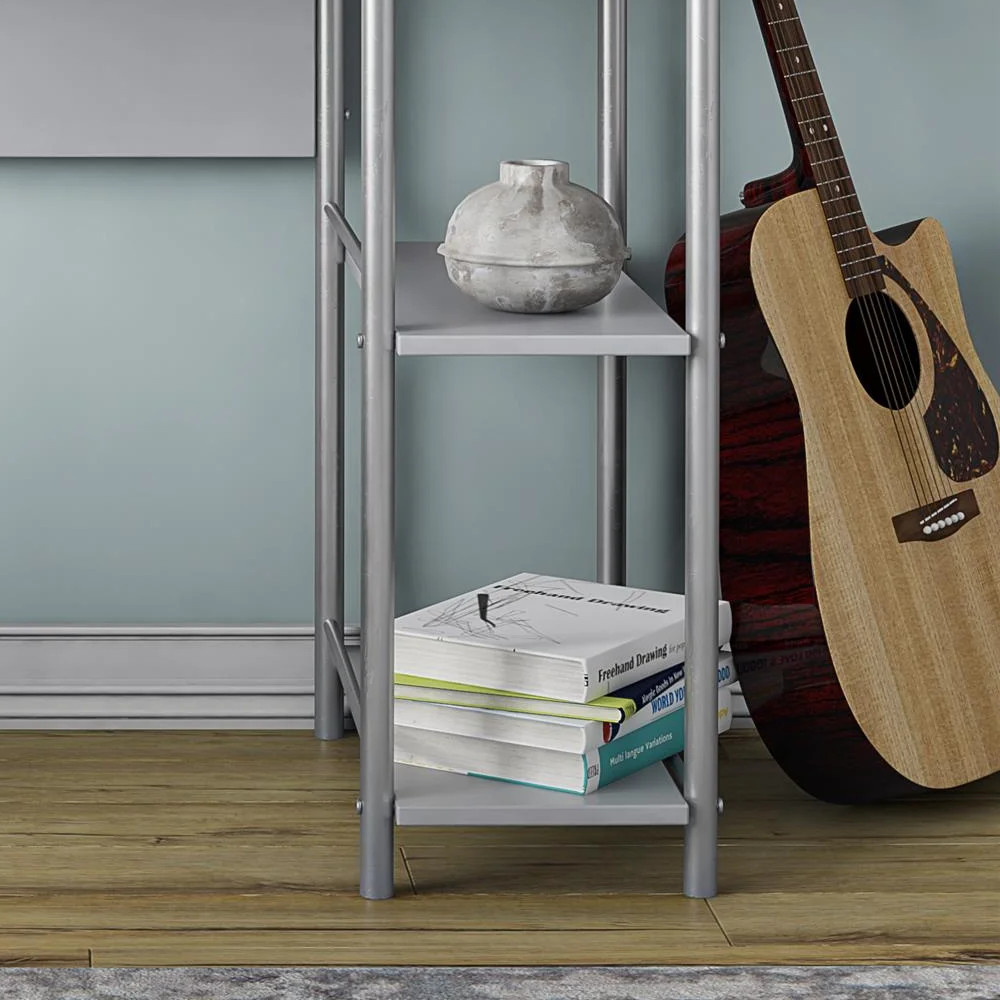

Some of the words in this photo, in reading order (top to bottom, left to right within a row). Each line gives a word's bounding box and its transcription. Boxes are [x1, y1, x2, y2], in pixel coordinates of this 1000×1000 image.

[598, 656, 634, 683] Freehand
[636, 643, 668, 667] Drawing
[651, 691, 674, 714] WORLD
[610, 754, 624, 767] Multi
[624, 745, 644, 760] langue
[645, 732, 673, 750] Variations
